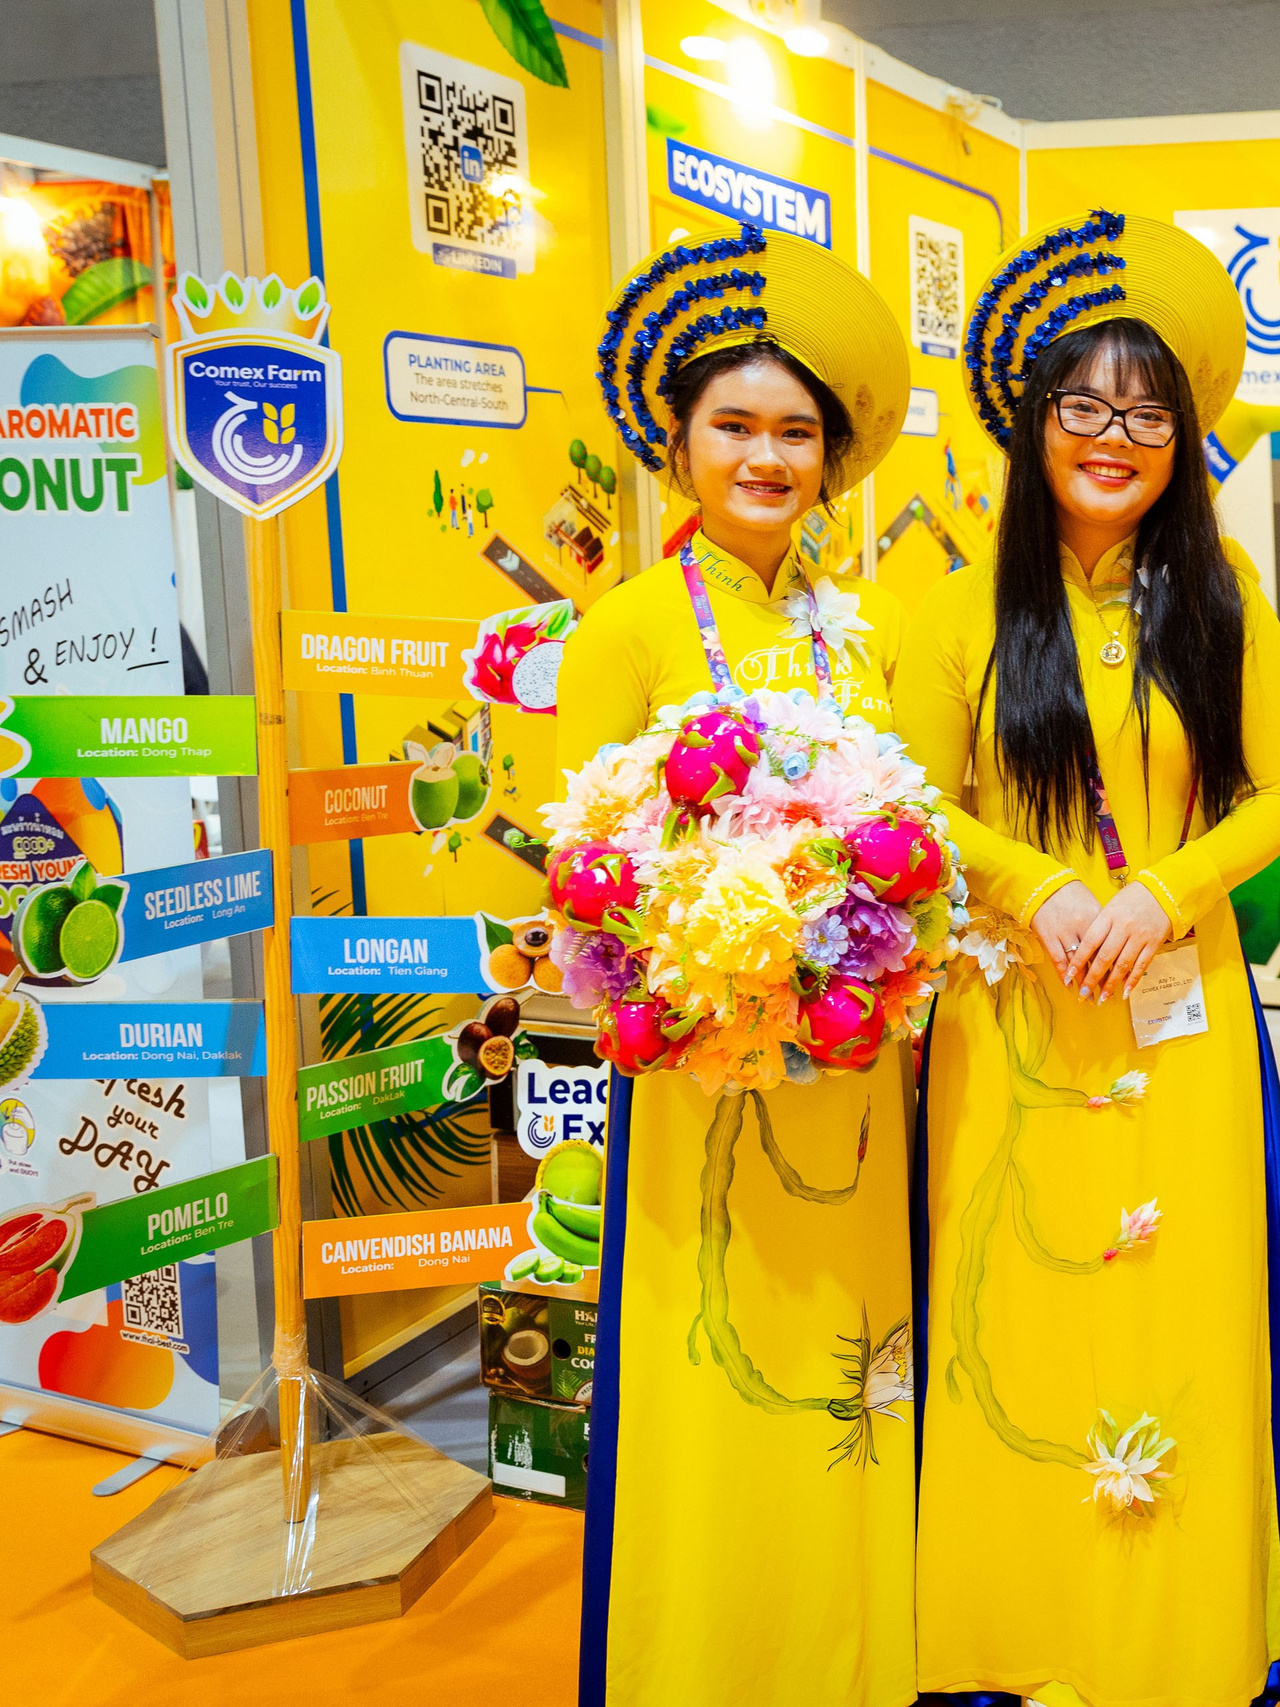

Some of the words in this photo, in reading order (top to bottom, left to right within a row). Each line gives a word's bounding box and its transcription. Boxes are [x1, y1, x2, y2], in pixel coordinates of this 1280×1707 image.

[672, 149, 826, 245] ECOSYSTEM
[188, 361, 264, 380] Comex
[267, 364, 322, 382] Farm
[408, 354, 471, 373] PLANTING
[475, 362, 506, 377] AREA
[414, 372, 433, 386] The
[436, 376, 457, 389] area
[460, 378, 503, 393] stretches
[410, 391, 509, 411] North-Central-South
[0, 578, 73, 647] SMASH
[24, 648, 48, 685] &
[55, 627, 135, 666] ENJOY
[301, 634, 384, 664] DRAGON
[391, 639, 450, 668] FRUIT
[316, 664, 368, 675] Location:
[371, 666, 396, 676] Binh
[399, 668, 433, 678] Thuan
[100, 717, 188, 744] MANGO
[77, 748, 138, 758] Location:
[142, 748, 176, 758] Dong
[180, 748, 212, 757] Thap
[324, 784, 388, 814] COCONUT
[324, 815, 360, 826] Location:
[144, 878, 224, 921] SEEDLESS
[226, 870, 262, 903] LIME
[164, 913, 204, 930] Location:
[212, 907, 232, 919] Long
[234, 904, 246, 914] An
[344, 938, 428, 964] LONGAN
[328, 966, 381, 976] Location:
[388, 966, 412, 976] Tien
[415, 966, 448, 978] Giang
[119, 1023, 203, 1048] DURIAN
[82, 1052, 138, 1060] Location:
[142, 1052, 174, 1062] Dong
[177, 1052, 199, 1061] Nai,
[202, 1051, 242, 1060] Daklak
[306, 1071, 376, 1112] PASSION
[380, 1058, 424, 1091] FRUIT
[107, 1105, 159, 1140] your
[320, 1103, 362, 1120] Location:
[59, 1116, 170, 1194] DAY
[148, 1192, 228, 1240] POMELO
[140, 1232, 192, 1256] Location:
[194, 1226, 215, 1238] Ben
[217, 1219, 234, 1230] Tre
[321, 1233, 435, 1264] CANVENDISH
[440, 1226, 513, 1253] BANANA
[341, 1262, 394, 1274] Location:
[418, 1256, 449, 1268] Dong
[452, 1254, 470, 1264] Nai
